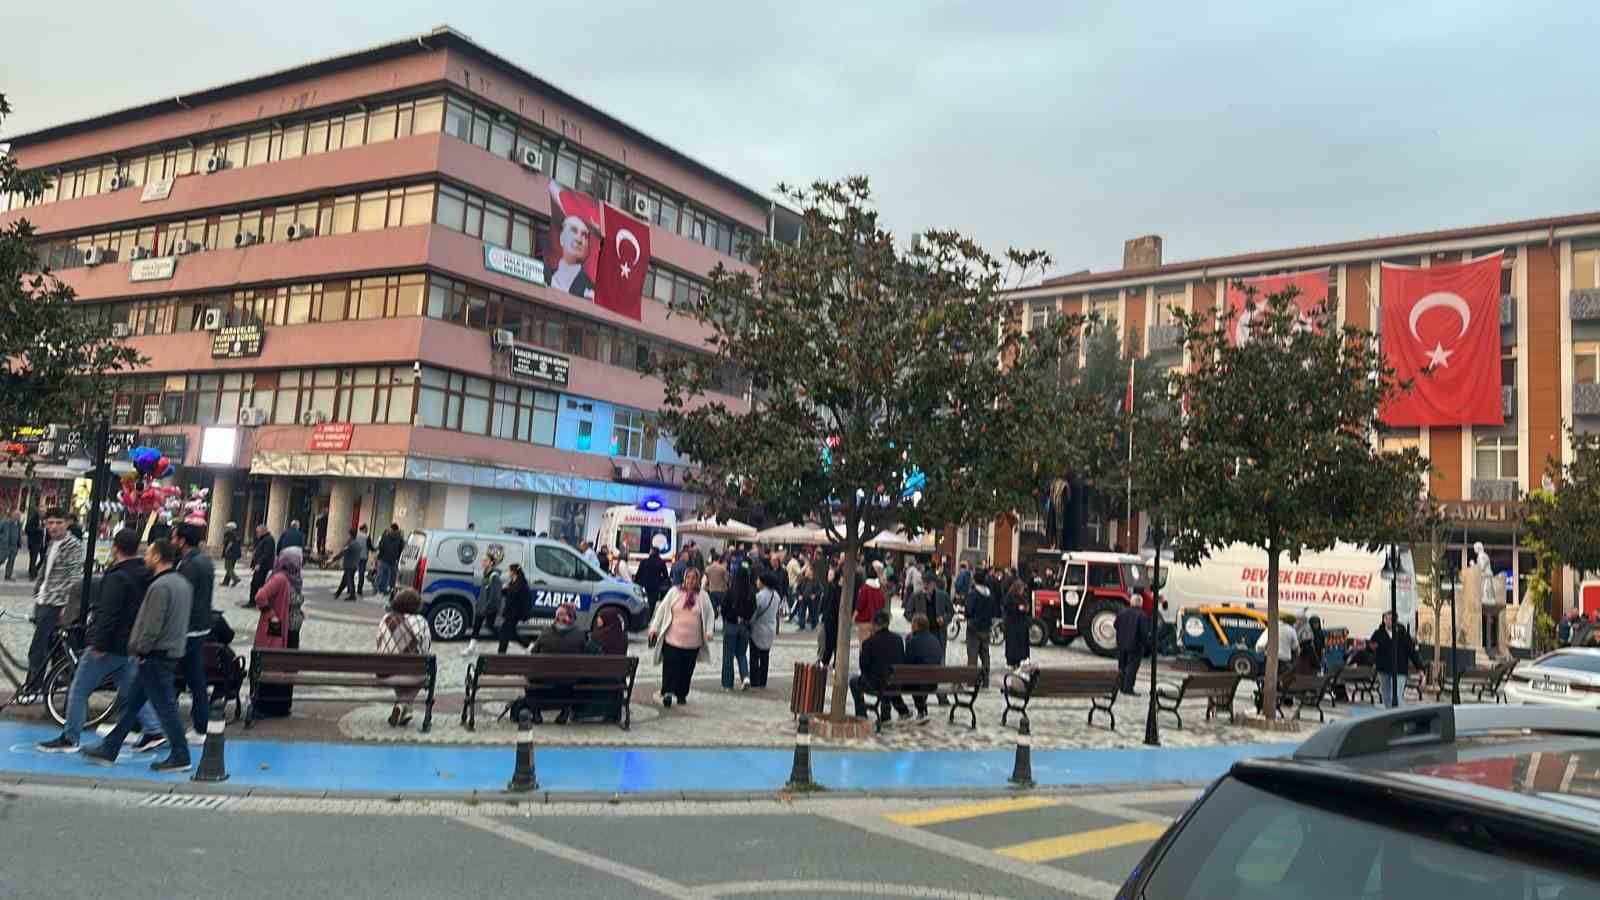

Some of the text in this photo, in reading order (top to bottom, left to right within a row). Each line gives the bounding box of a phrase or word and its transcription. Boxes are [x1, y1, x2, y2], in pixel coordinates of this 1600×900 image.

[1242, 568, 1373, 590] DEVEK BELEDİYESİ
[535, 590, 581, 609] ZABITA
